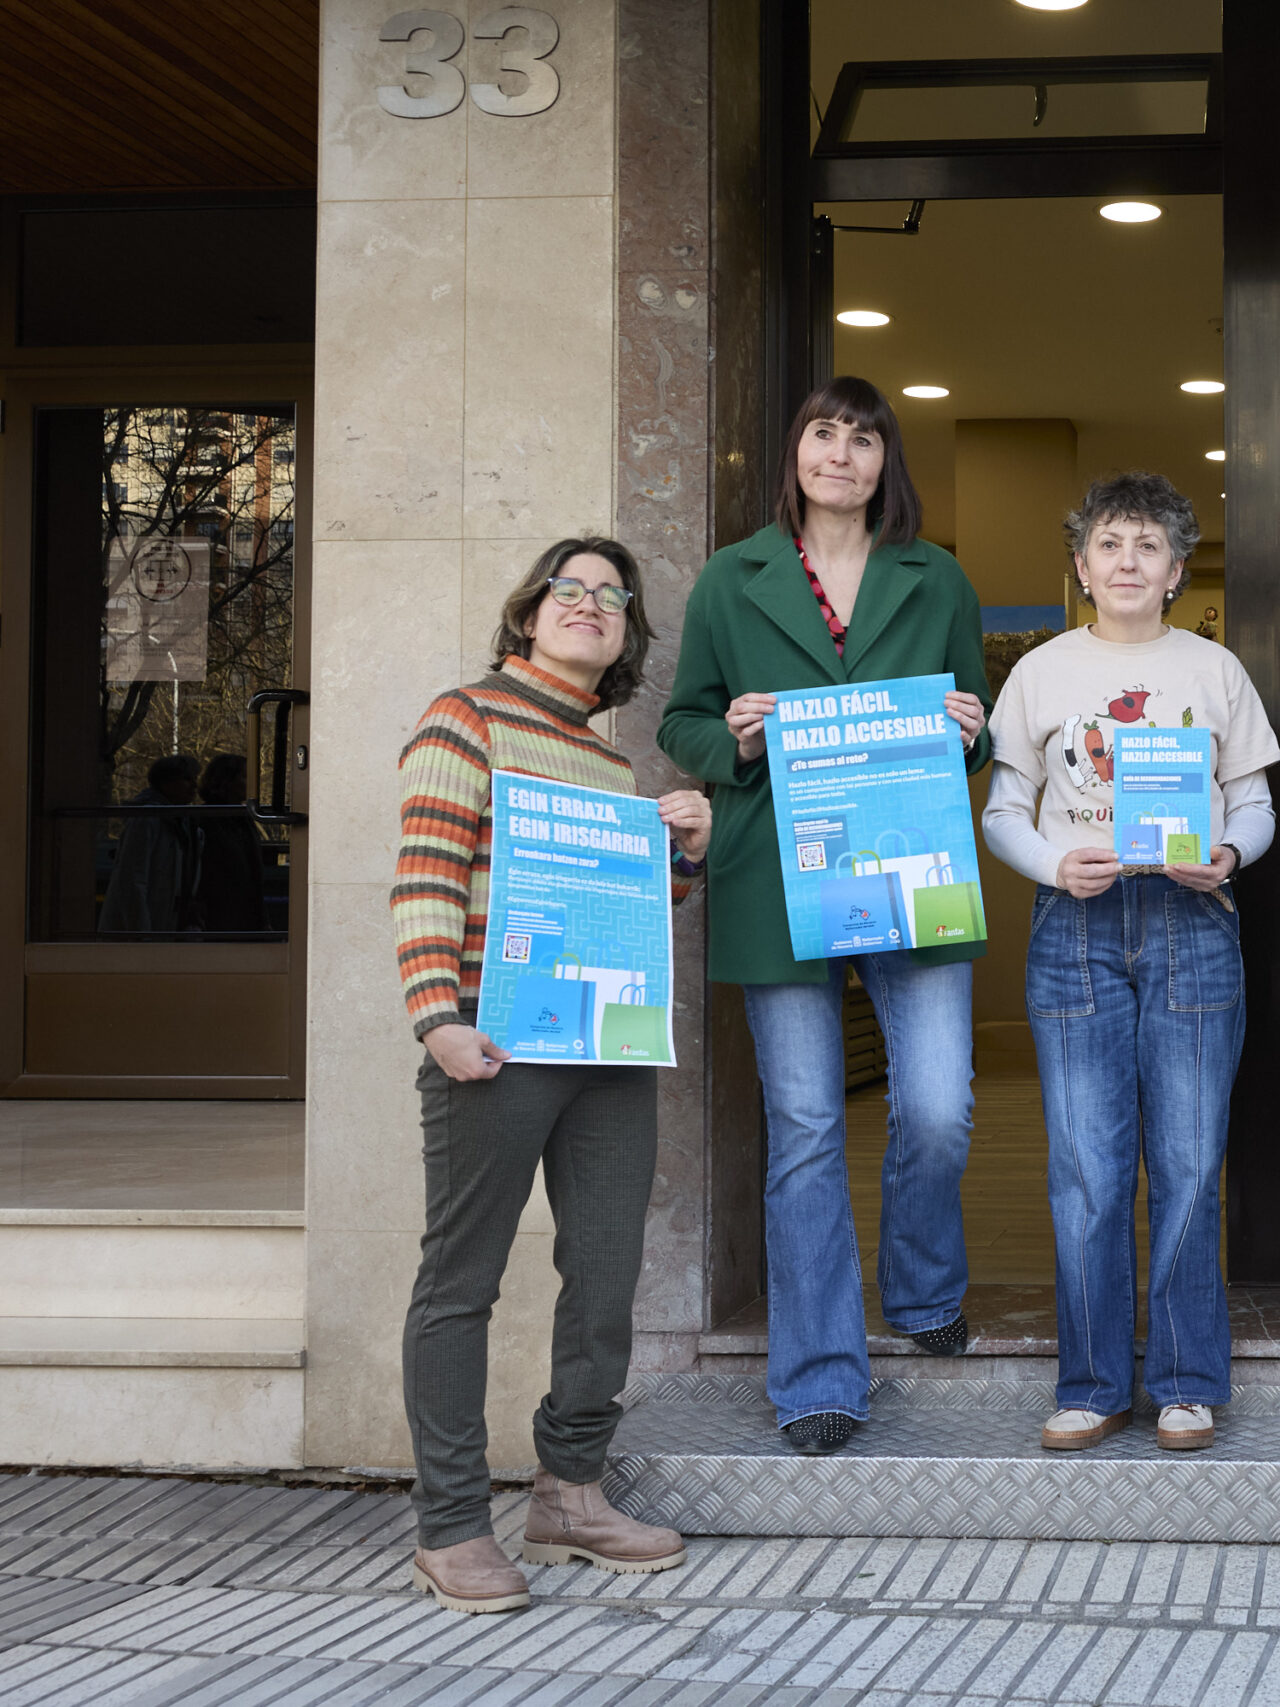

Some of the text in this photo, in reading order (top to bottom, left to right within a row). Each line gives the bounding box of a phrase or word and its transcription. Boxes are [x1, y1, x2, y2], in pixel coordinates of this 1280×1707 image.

[377, 7, 561, 119] 33
[779, 690, 898, 723] HAZLO FÁCIL,
[782, 713, 947, 752] HAZLO ACCESIBLE
[1121, 737, 1150, 748] HAZLO
[1121, 751, 1203, 763] HAZLO ACCESIBLE
[508, 787, 622, 826] EGIN ERRAZA,
[509, 815, 650, 857] EGIN IRISGARRIA
